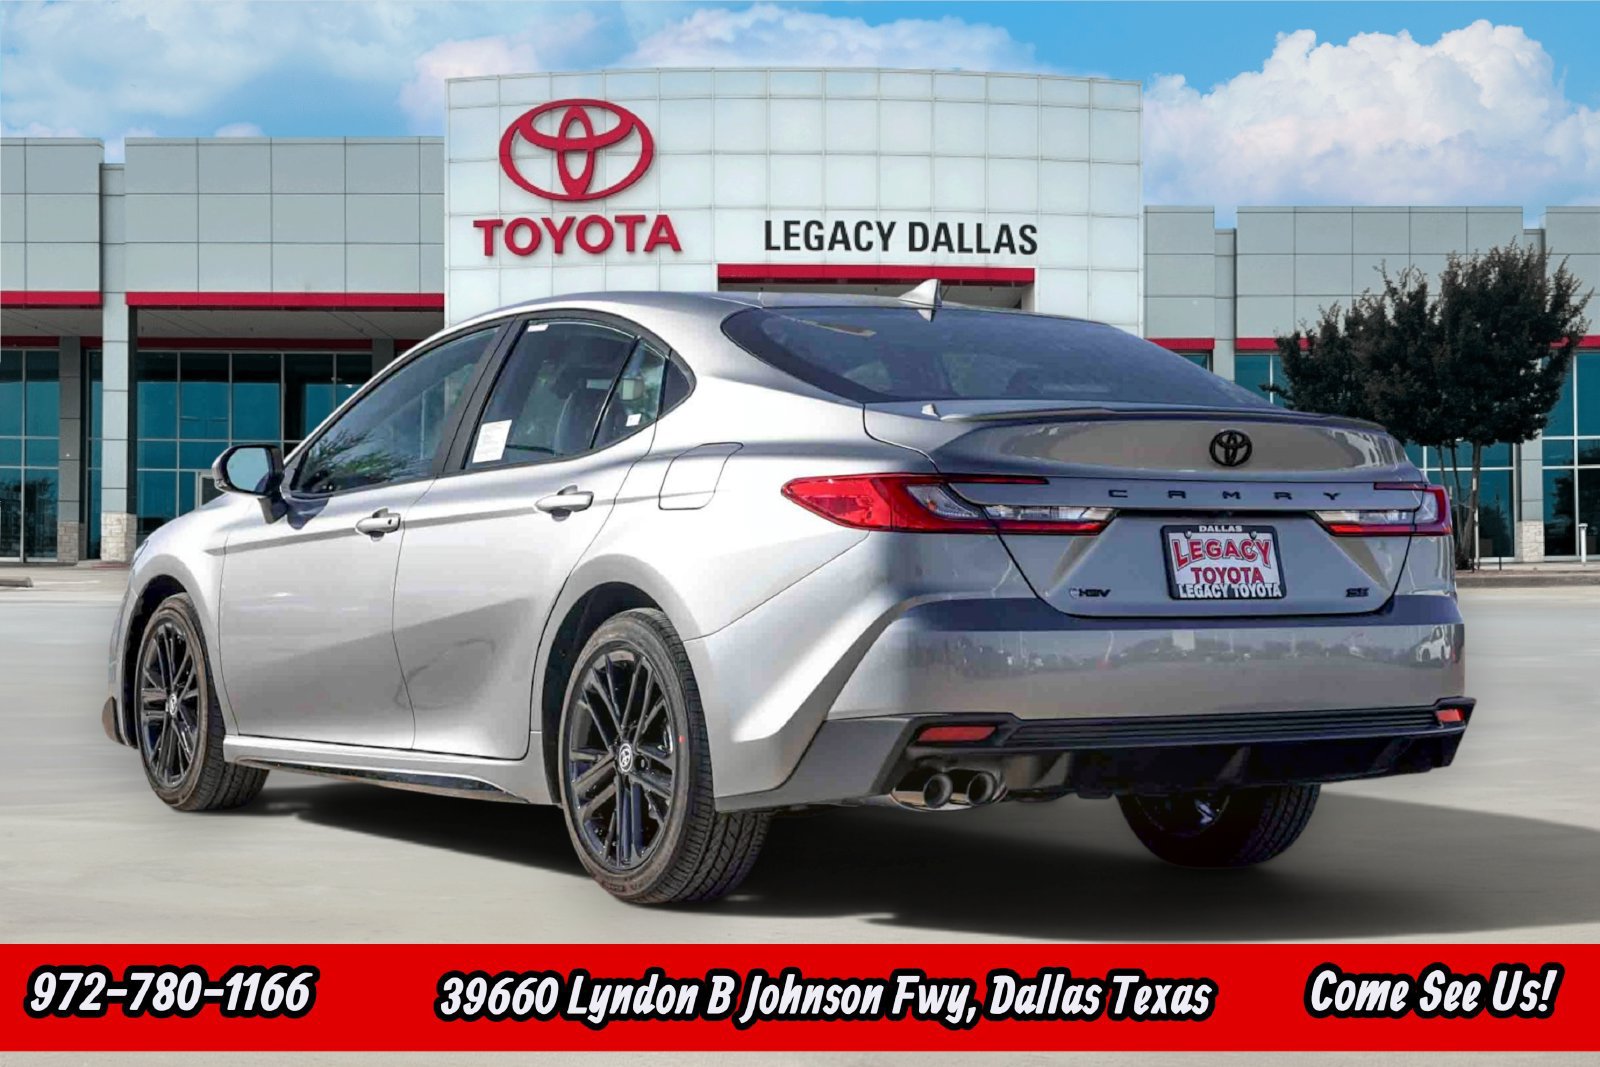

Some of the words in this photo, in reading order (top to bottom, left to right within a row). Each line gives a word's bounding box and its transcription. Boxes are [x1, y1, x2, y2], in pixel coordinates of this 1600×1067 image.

[473, 214, 682, 257] TOYOTA
[764, 220, 897, 252] LEGACY
[908, 222, 1038, 255] DALLAS
[1107, 488, 1342, 501] CAMRY
[1199, 525, 1243, 533] DALLAS
[1172, 539, 1271, 571] LEGACY
[1190, 566, 1265, 585] TOYOTA
[1179, 583, 1229, 599] LEGACY
[1231, 583, 1281, 598] TOYOTA
